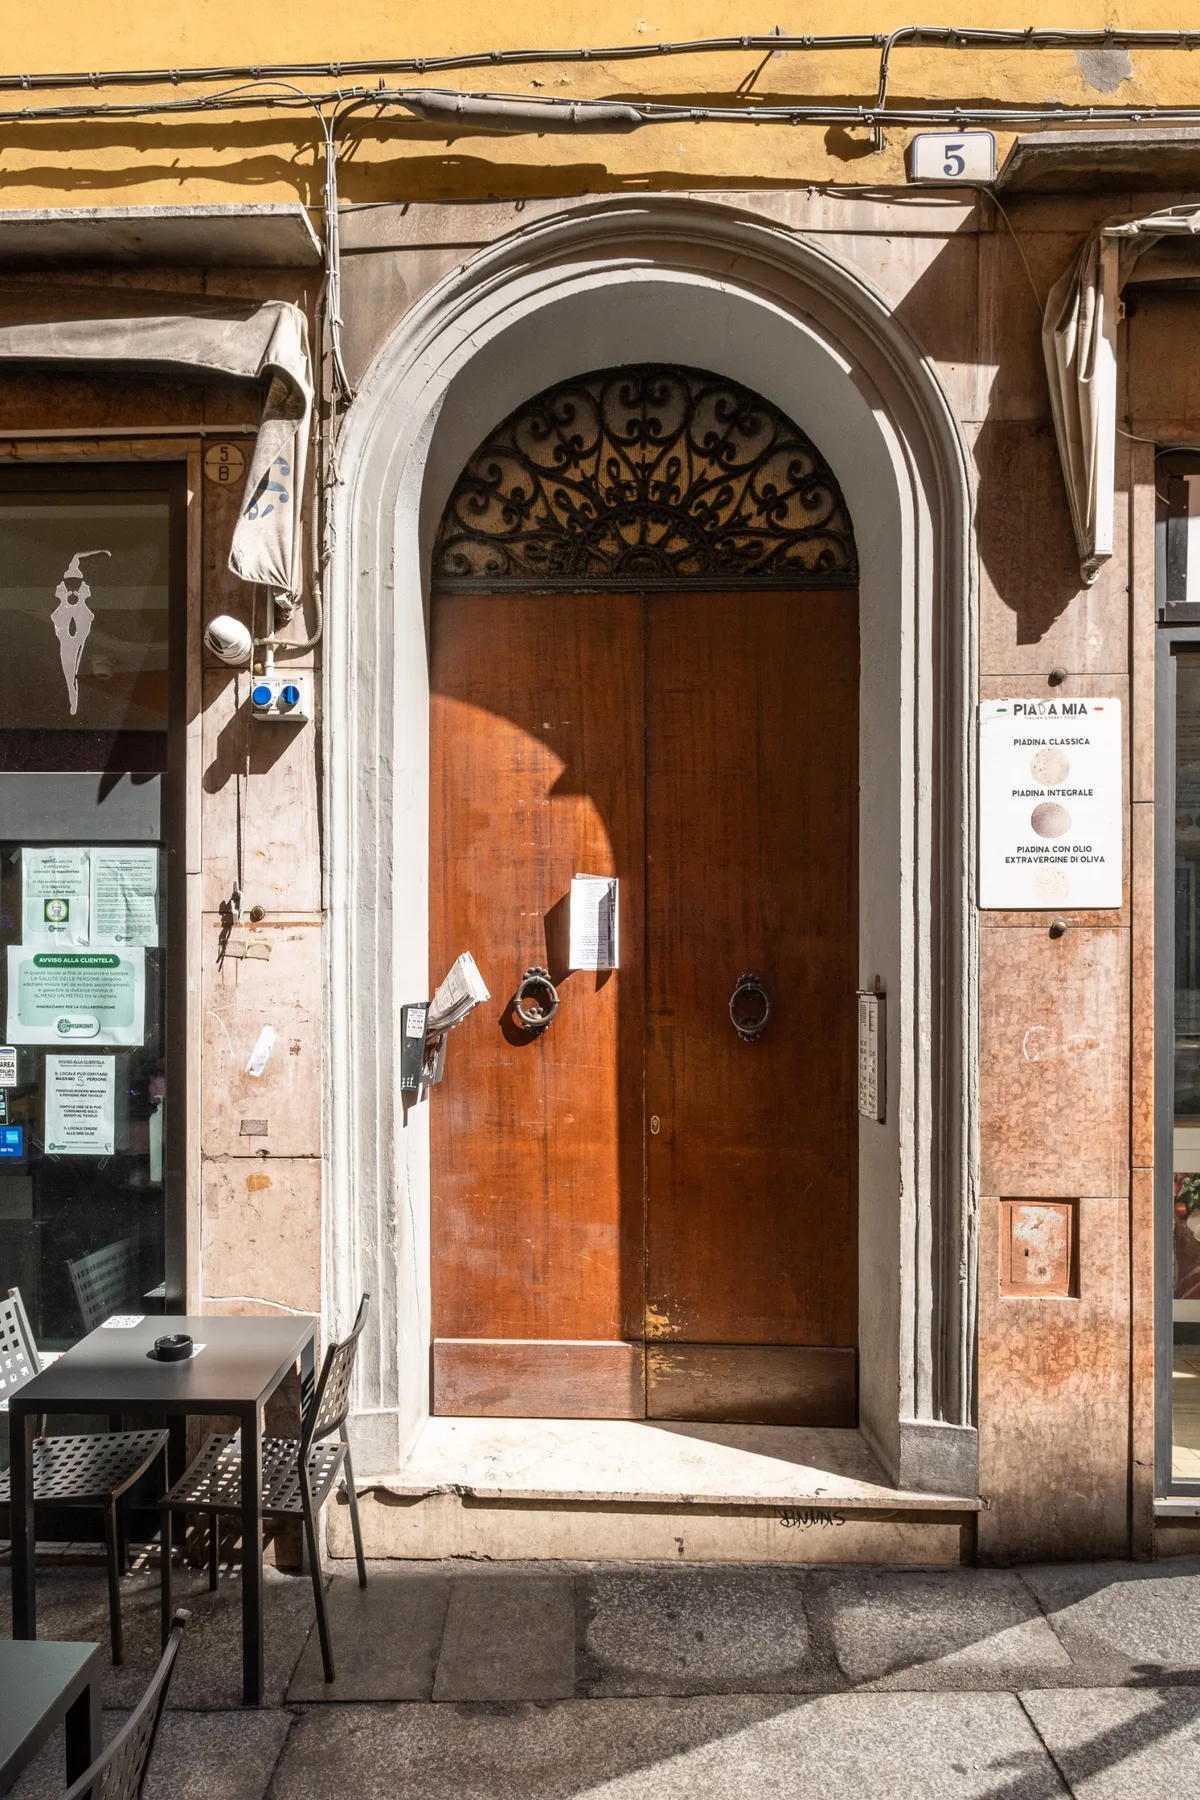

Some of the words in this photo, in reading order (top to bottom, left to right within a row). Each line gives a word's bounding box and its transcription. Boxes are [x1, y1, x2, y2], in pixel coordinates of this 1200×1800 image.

[943, 144, 965, 177] 5
[220, 447, 228, 462] 5
[219, 466, 229, 481] B
[1013, 703, 1058, 716] PIADA
[1062, 703, 1088, 715] MIA
[1013, 738, 1047, 746] PIADINA
[1048, 738, 1090, 746] CLASSICA
[1011, 789, 1045, 797] PIADINA
[1047, 789, 1094, 797] INTEGRALE
[1005, 856, 1068, 864] EXTRAVERGINE
[1070, 856, 1078, 864] DI
[1081, 856, 1105, 864] OLIVA
